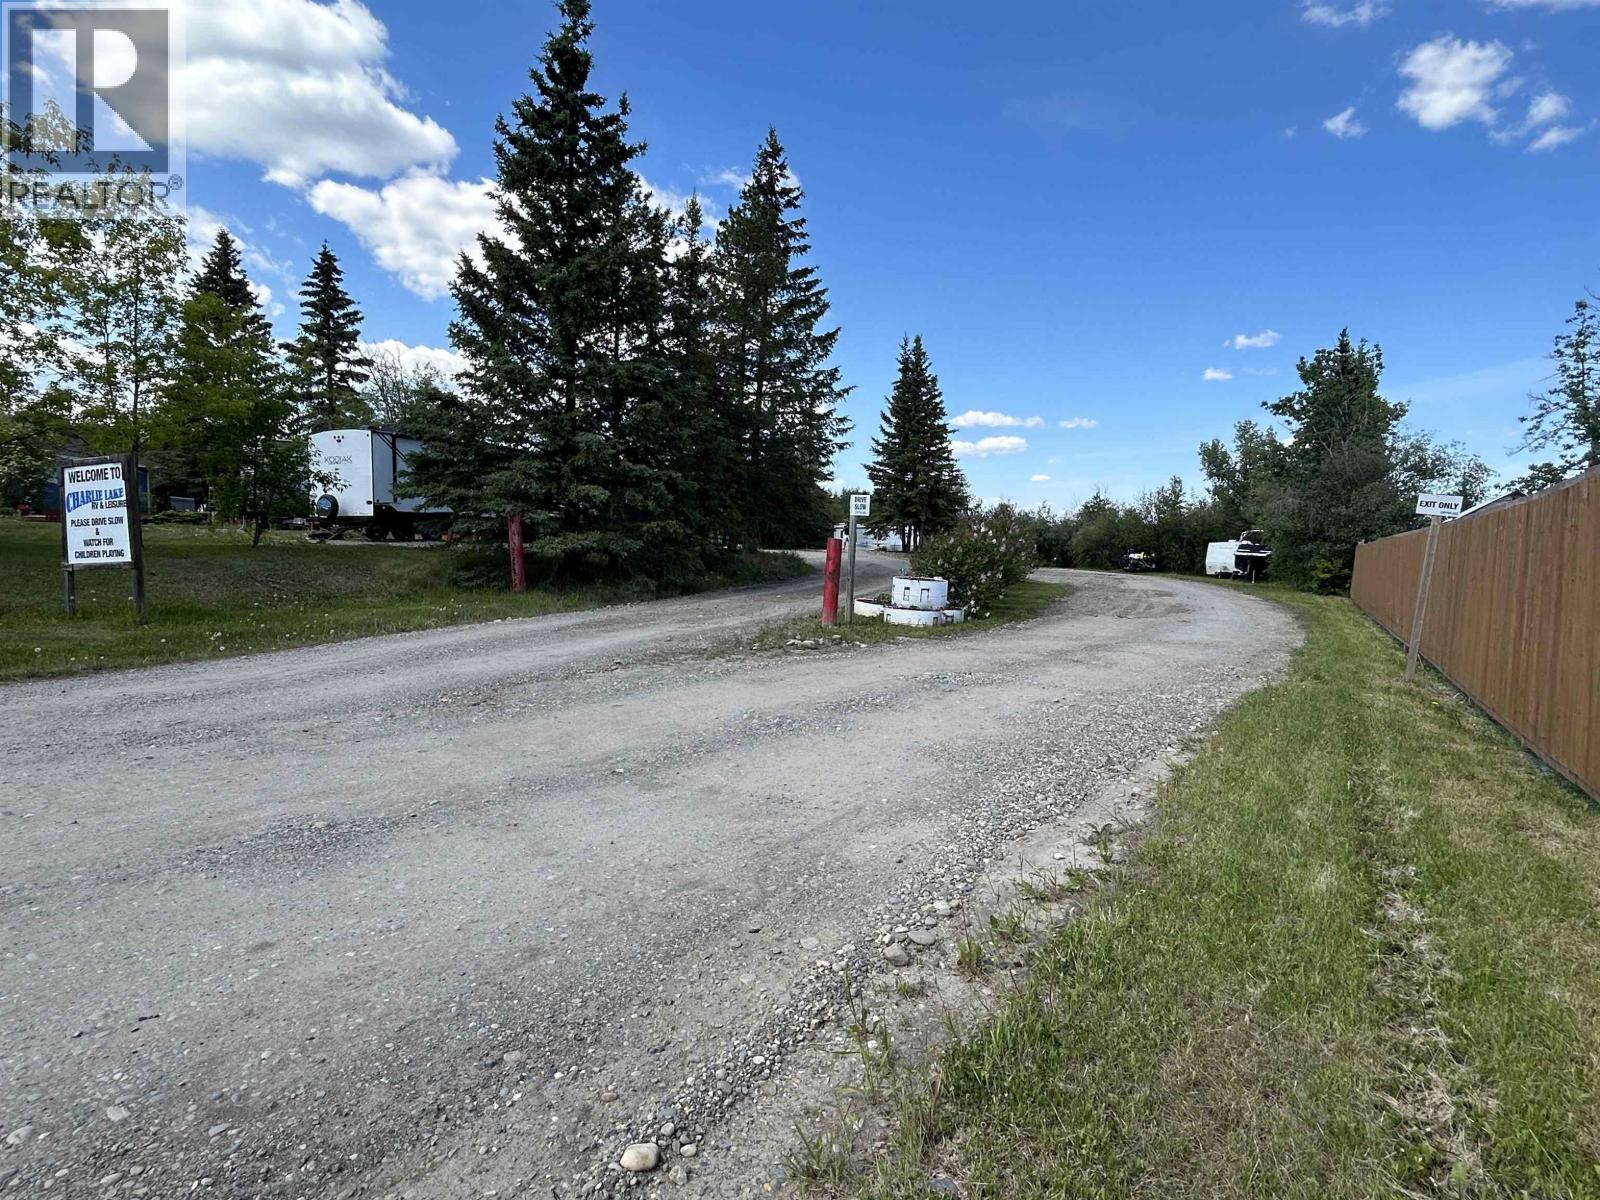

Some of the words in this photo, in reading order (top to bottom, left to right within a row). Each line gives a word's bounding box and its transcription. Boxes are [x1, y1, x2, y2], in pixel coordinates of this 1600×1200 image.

[324, 455, 352, 465] KODIAK
[68, 468, 109, 484] WELCOME
[110, 466, 121, 480] TO
[66, 490, 103, 512] CHARLIE
[105, 487, 124, 500] LAKE
[91, 501, 99, 510] RV
[100, 501, 104, 509] &
[105, 500, 128, 508] LEISURE
[1420, 500, 1437, 508] EXIT
[1438, 501, 1459, 510] ONLY
[71, 518, 90, 527] PLEASE
[91, 517, 107, 526] DRIVE
[108, 516, 124, 525] SLOW
[95, 527, 100, 536] &
[83, 538, 102, 547] WATCH
[103, 538, 114, 546] FOR
[74, 550, 101, 559] CHILDREN
[102, 549, 125, 558] PLAYING
